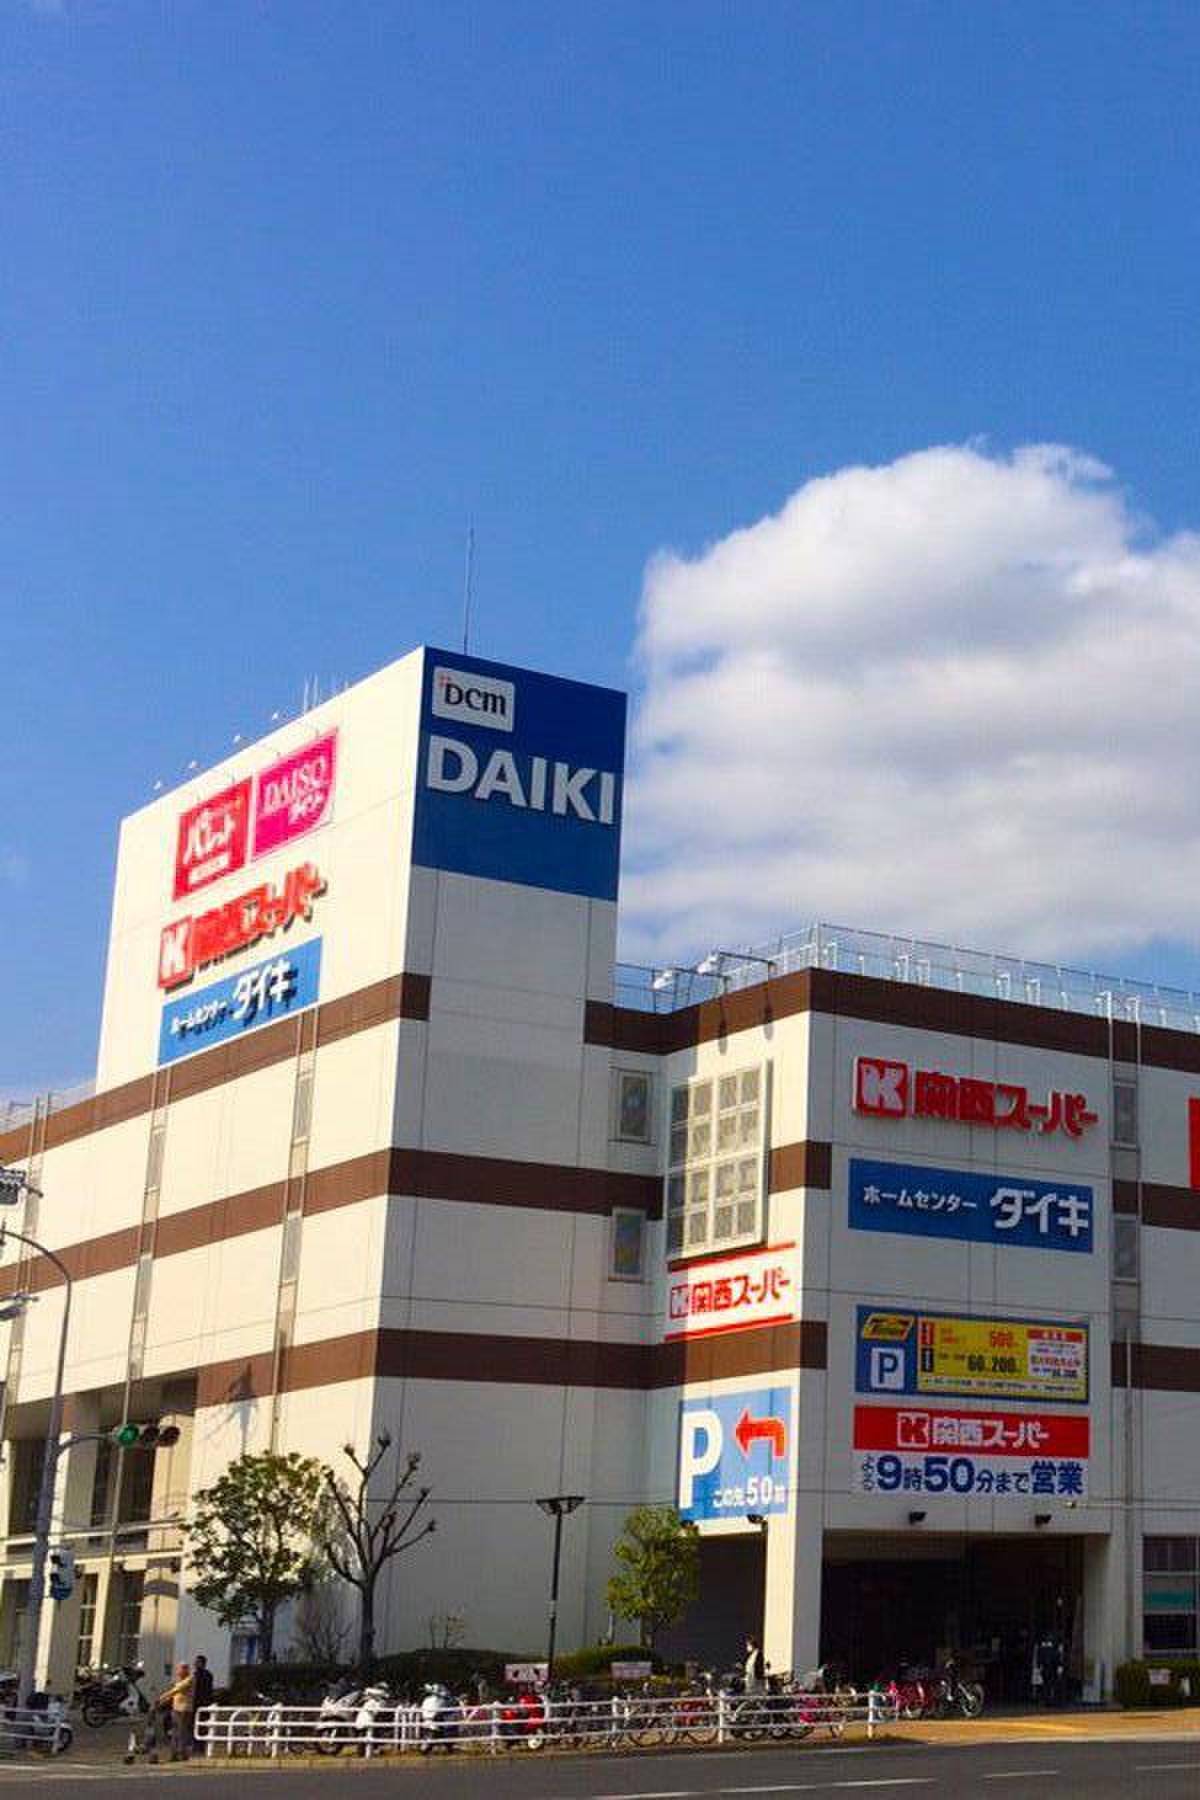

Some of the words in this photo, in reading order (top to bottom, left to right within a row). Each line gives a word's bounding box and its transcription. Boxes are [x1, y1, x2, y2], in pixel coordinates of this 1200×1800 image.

[426, 734, 615, 826] DAIKI
[856, 1058, 907, 1117] K
[862, 1184, 978, 1213] ホームセンター
[990, 1186, 1090, 1238] ダイキ
[878, 1351, 899, 1385] P
[678, 1409, 723, 1509] P
